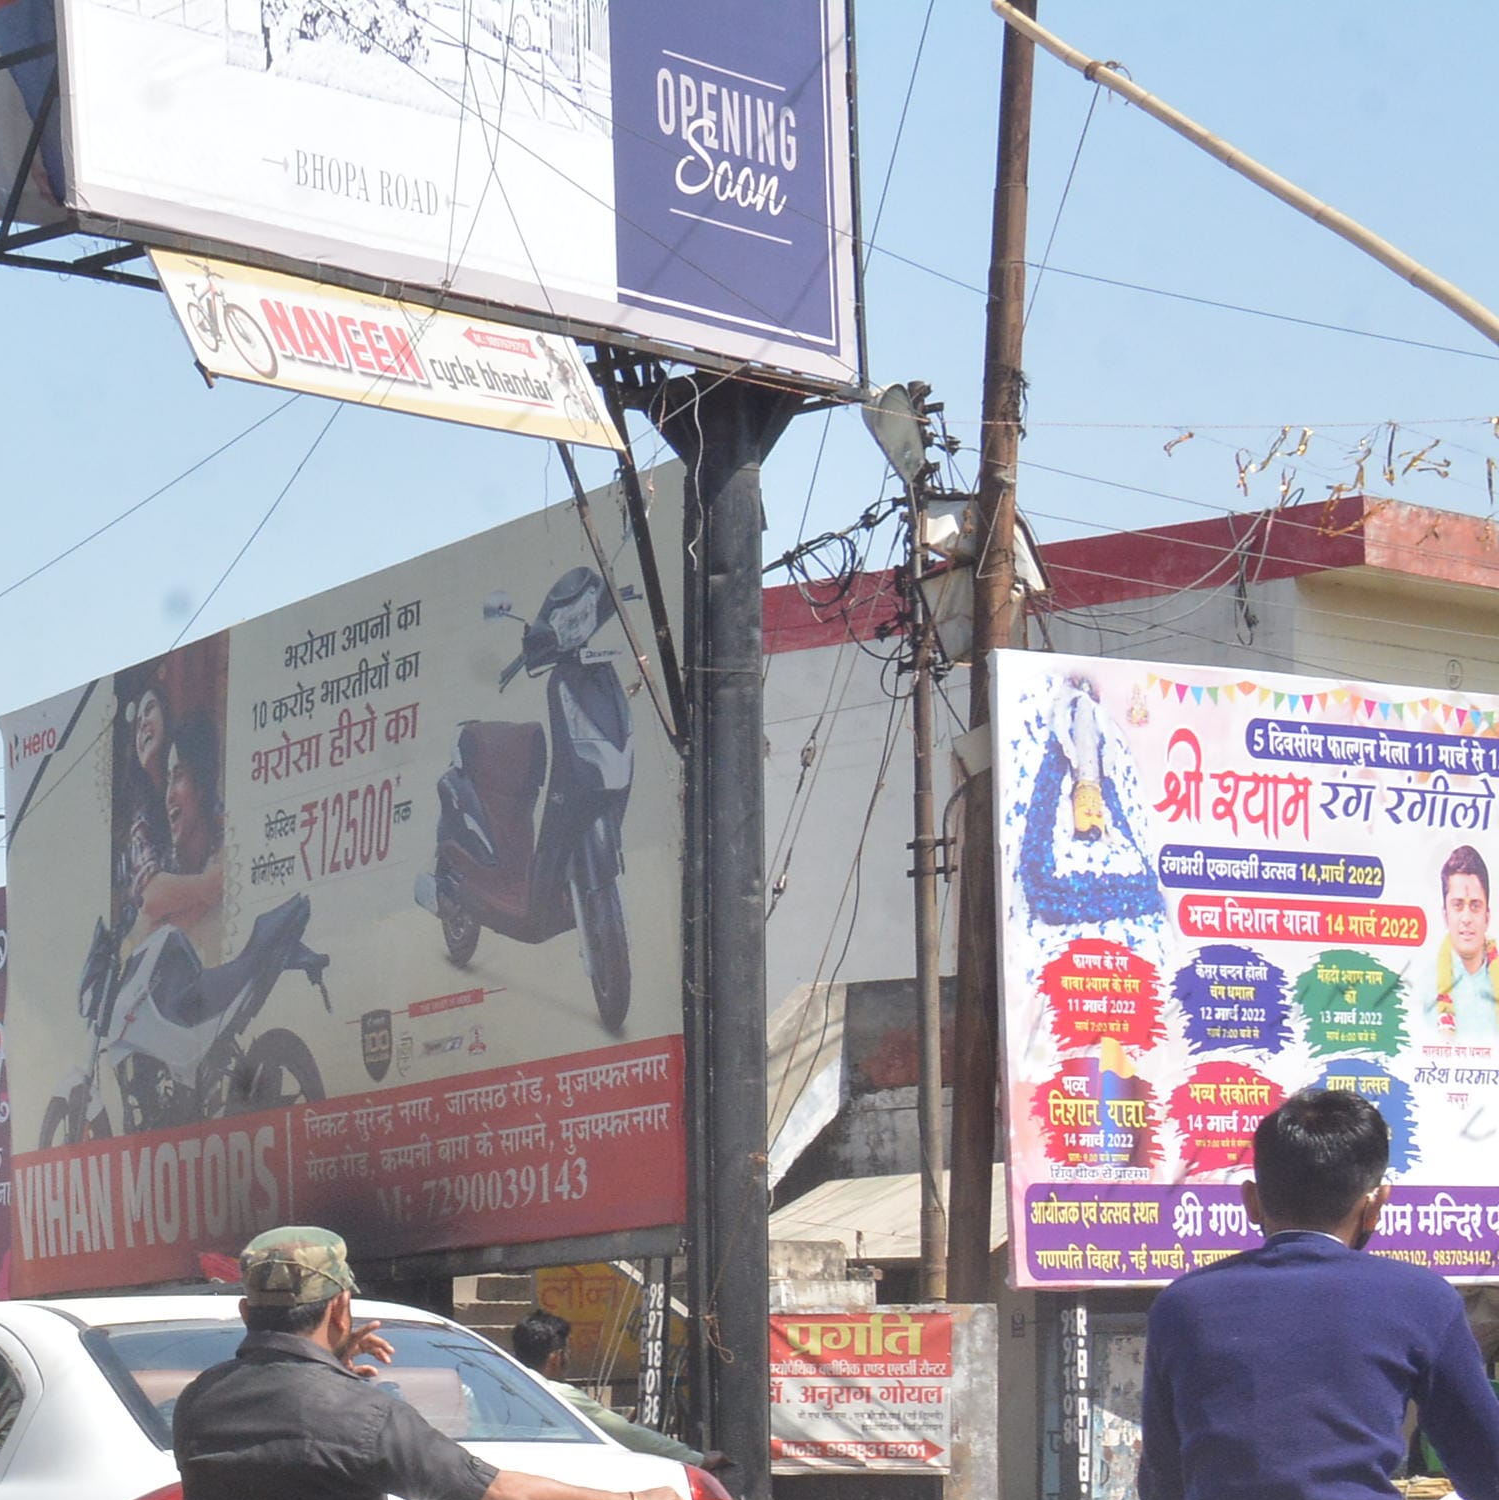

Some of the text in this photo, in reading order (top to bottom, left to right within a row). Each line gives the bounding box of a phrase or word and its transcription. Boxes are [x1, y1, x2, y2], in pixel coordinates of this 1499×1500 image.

[656, 68, 800, 171] OPENING
[295, 149, 438, 216] BHOPA ROAD
[674, 119, 789, 217] Soon
[260, 298, 429, 386] NAVEEN
[431, 356, 477, 392] cycle
[481, 363, 554, 401] bhandar
[285, 600, 421, 670] भरोसा अपनों का
[253, 650, 421, 731] 10 करोड़ भारतीयों का
[252, 702, 420, 785] भरोसा हीरो का
[1254, 722, 1487, 771] 5 दिवसीय फाल्गुन मेला 11 मार्च से
[1153, 727, 1376, 842] श्री श्याम रंग
[393, 801, 412, 824] तक
[1161, 851, 1383, 886] रंगभरी एकादशी उत्सव 2022
[1188, 897, 1419, 939] भव्य निशान यात्रा 14 मार्च 2022
[1082, 996, 1136, 1014] मार्च 2022
[1241, 1008, 1266, 1021] 2022
[1062, 1076, 1090, 1097] भव्य
[1189, 1083, 1216, 1104] भव्य
[1414, 1061, 1499, 1086] महेश परमार
[304, 1070, 552, 1141] निकट नगर, जानसठ रोड,
[1048, 1089, 1147, 1128] निशान यात्रा
[1187, 1109, 1240, 1132] 14 मार्च
[438, 1113, 554, 1163] बाग के सामने,
[1063, 1130, 1134, 1149] 14 मार्च 2022
[15, 1125, 279, 1261] VIHAN MOTORS
[422, 1157, 587, 1219] 7290039143
[1031, 1193, 1079, 1225] आयोजक
[1082, 1195, 1097, 1228] एवं
[1100, 1202, 1130, 1224] उत्सव
[1133, 1202, 1159, 1225] स्थल
[1173, 1192, 1204, 1238] श्री
[1418, 1192, 1482, 1242] मन्दिर
[1036, 1245, 1083, 1270] गणपति
[1087, 1244, 1125, 1272] विहार,
[1129, 1244, 1147, 1274] नई
[1151, 1244, 1189, 1272] मण्डी,
[648, 1283, 664, 1367] 98 97 18
[783, 1313, 923, 1357] प्रगति
[800, 1380, 943, 1410] अनुराग गोयल
[782, 1443, 926, 1457] Mob: 9958315201
